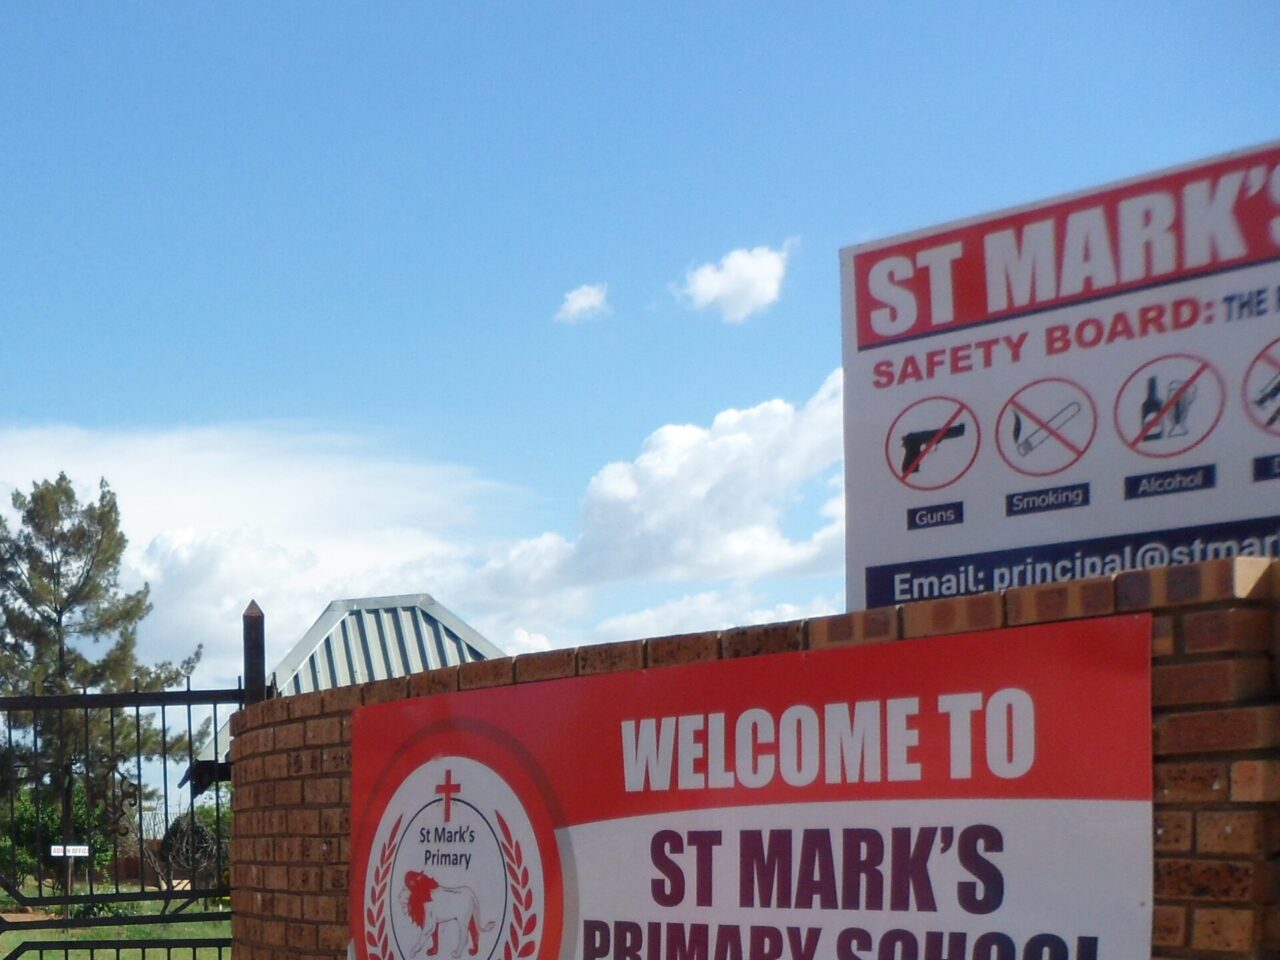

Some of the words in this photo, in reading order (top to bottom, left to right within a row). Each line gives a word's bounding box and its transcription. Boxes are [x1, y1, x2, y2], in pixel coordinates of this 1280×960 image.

[867, 241, 964, 339] ST
[983, 164, 1280, 315] MARK'
[872, 332, 1028, 390] SAFETY
[1045, 296, 1215, 357] BOARD:
[1222, 289, 1268, 323] THE
[1137, 470, 1204, 496] Alcohol
[1012, 489, 1084, 513] Smoking
[914, 508, 956, 527] Guns
[893, 564, 985, 601] Email:
[621, 697, 921, 792] WELCOME
[938, 688, 1036, 780] TO
[419, 827, 431, 843] St
[434, 825, 476, 844] Mark's
[424, 850, 472, 870] Primary
[650, 829, 722, 908] ST
[739, 825, 1005, 915] MARK'S
